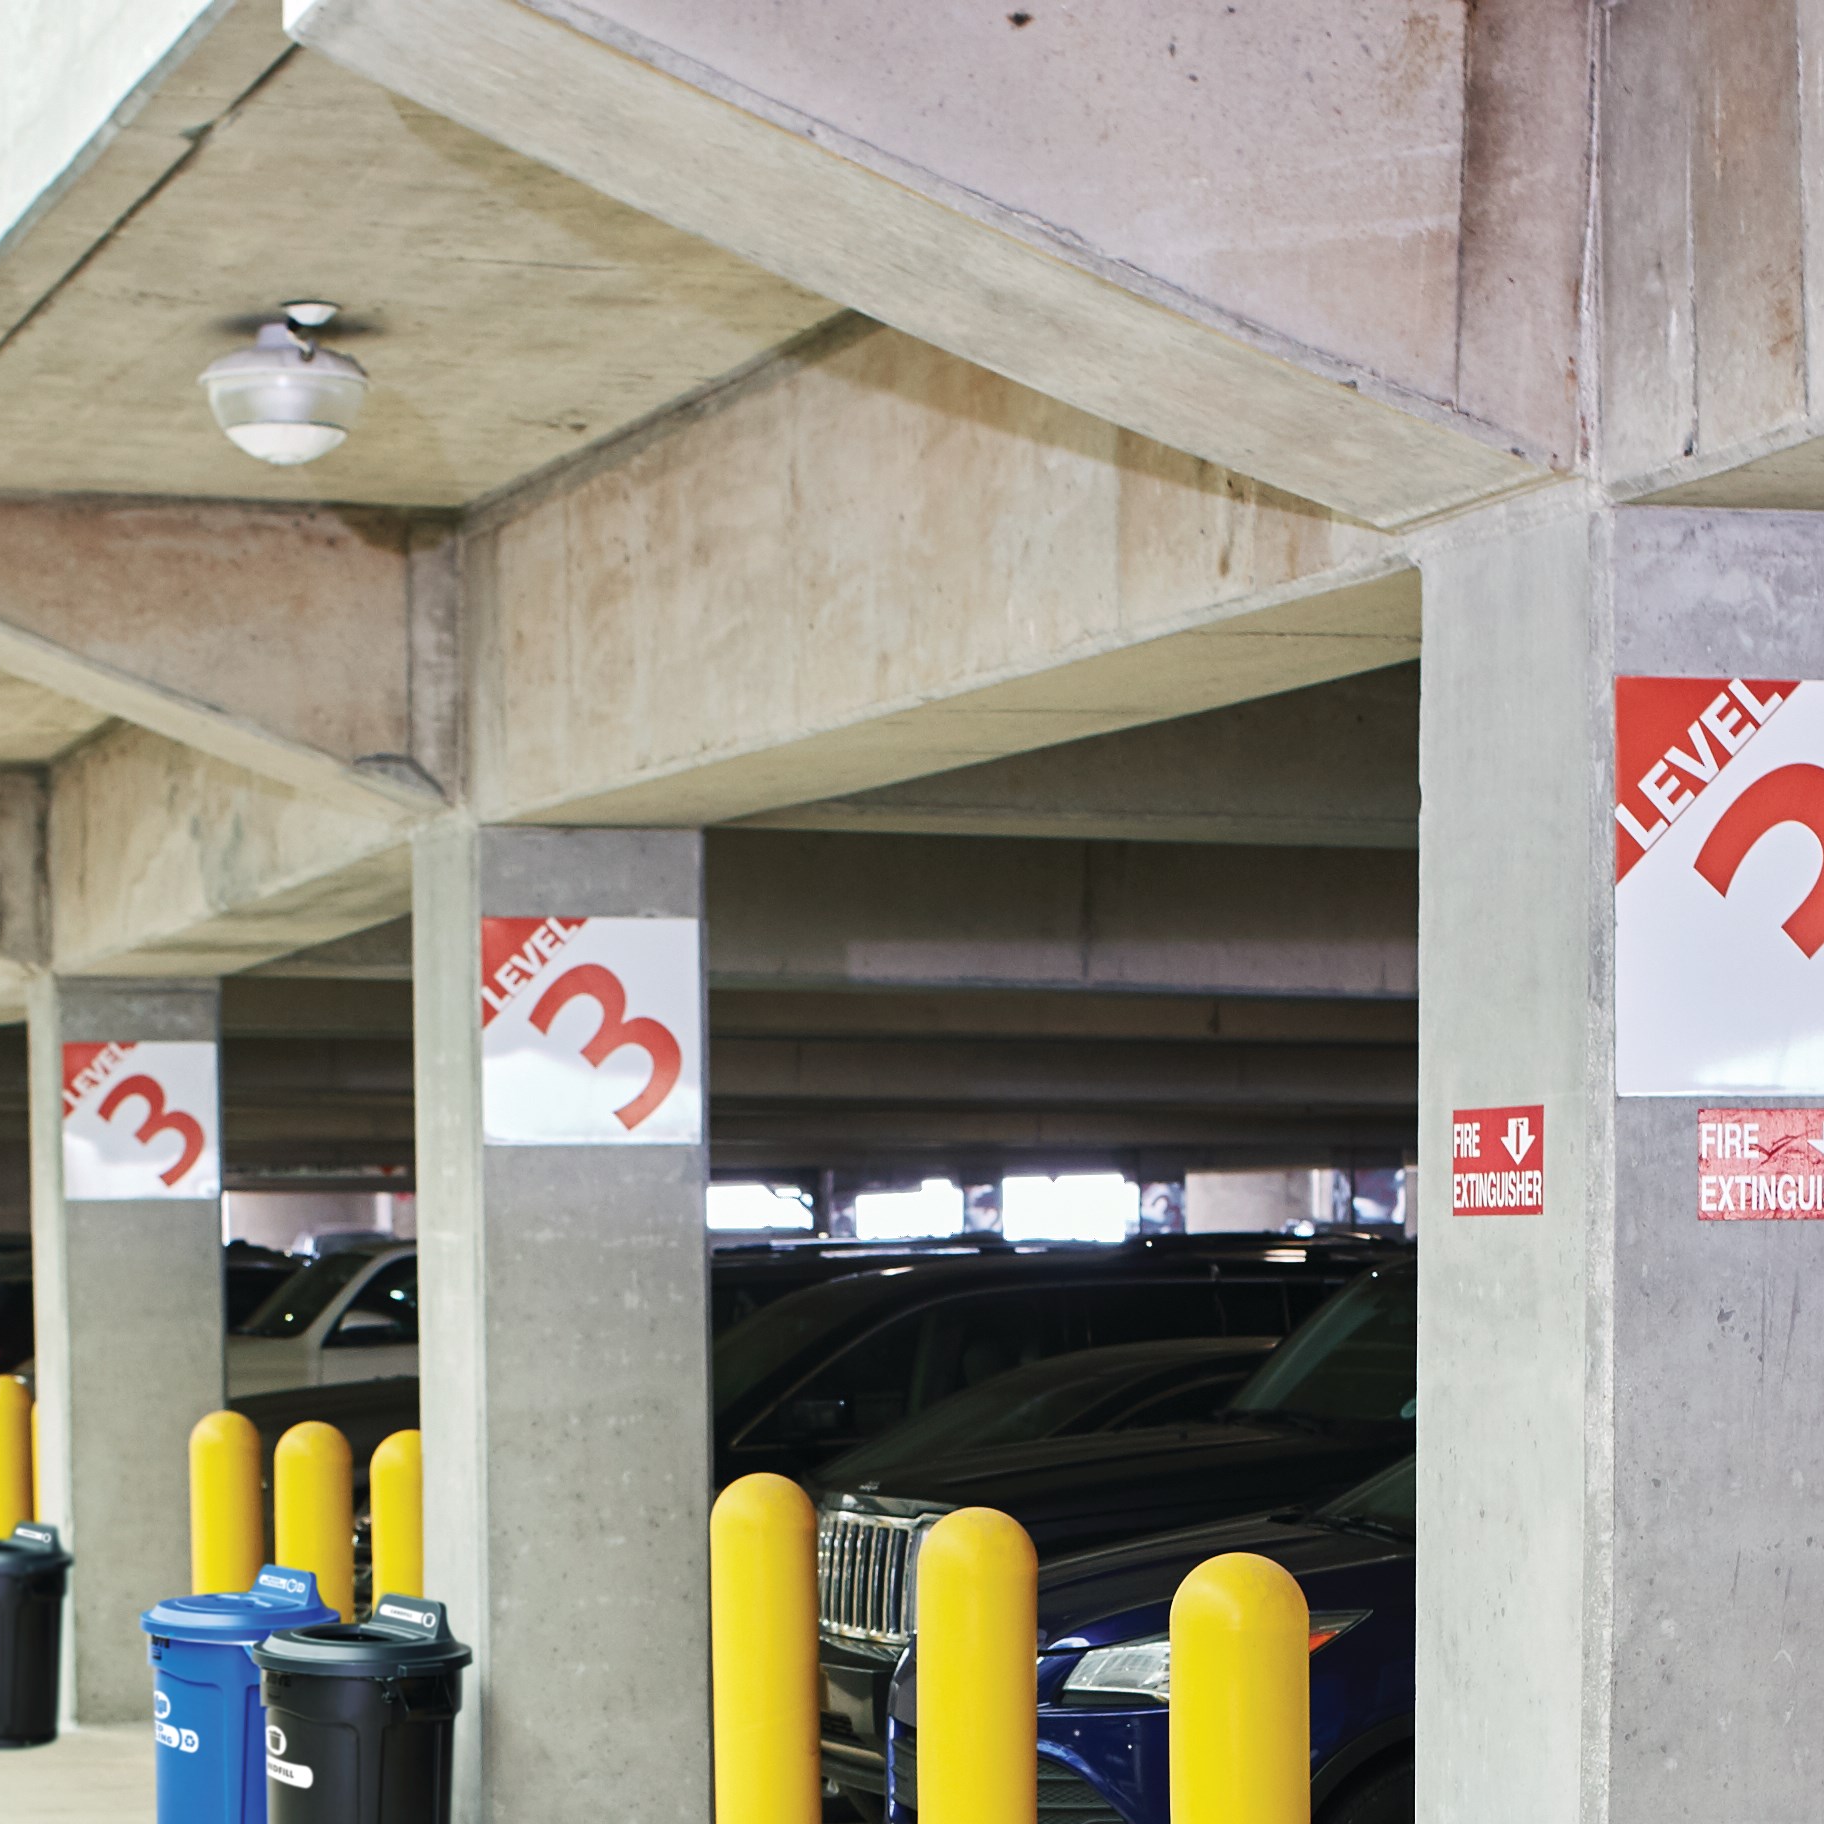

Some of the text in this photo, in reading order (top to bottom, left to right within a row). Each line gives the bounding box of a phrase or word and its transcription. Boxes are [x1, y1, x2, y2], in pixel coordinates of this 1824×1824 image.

[1616, 678, 1784, 852] LEVEL
[481, 917, 580, 1012] LEVEL
[529, 963, 682, 1131] 3
[98, 1074, 205, 1187] 3
[1453, 1122, 1480, 1158] FIRE
[1701, 1122, 1761, 1159] FIRE
[1453, 1170, 1543, 1209] EXTINGUISHER
